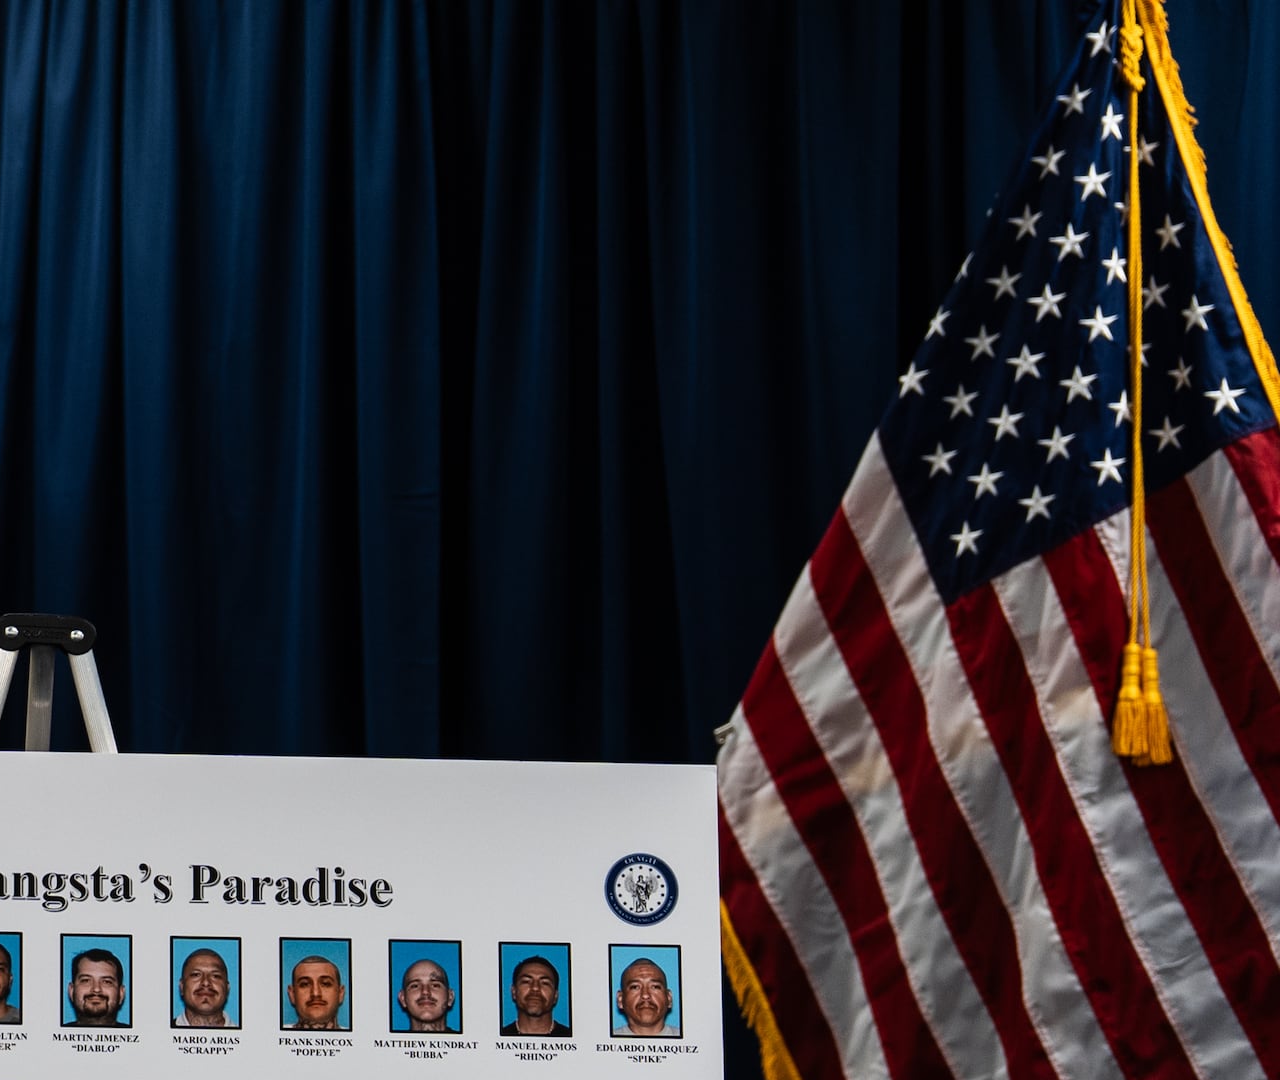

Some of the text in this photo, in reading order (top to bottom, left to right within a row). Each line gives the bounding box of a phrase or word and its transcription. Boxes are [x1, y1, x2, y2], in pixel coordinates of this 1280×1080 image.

[188, 864, 394, 908] Paradise
[52, 1032, 140, 1043] MARTIN JIMENEZ
[172, 1035, 240, 1045] MARIO ARIAS
[278, 1037, 353, 1047] FRANK SINCOX
[373, 1039, 427, 1048] MATTHEW
[495, 1041, 577, 1051] MANUEL RAMOS
[595, 1043, 690, 1055] EDUARDO MARQUEZ
